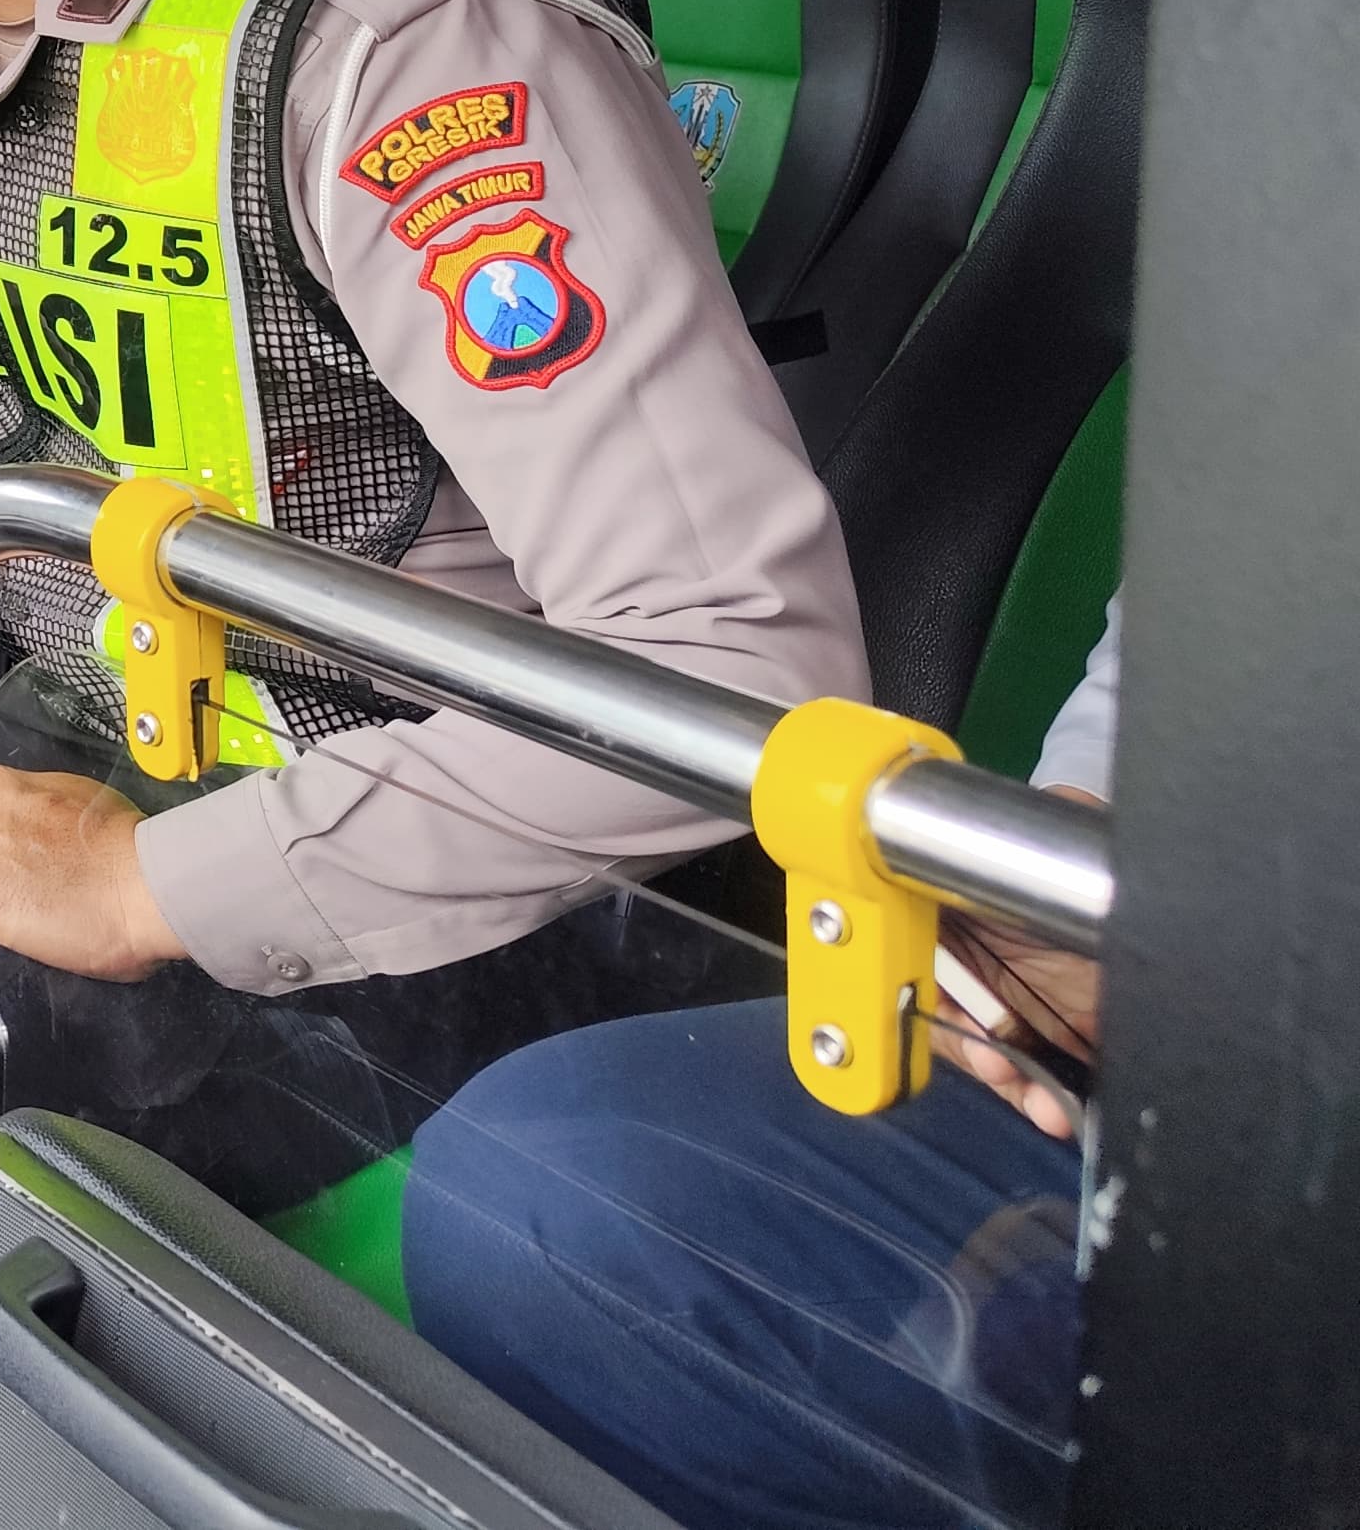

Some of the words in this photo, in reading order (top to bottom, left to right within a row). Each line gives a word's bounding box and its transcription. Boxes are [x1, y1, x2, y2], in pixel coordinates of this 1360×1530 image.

[359, 93, 511, 182] POLRES
[387, 119, 503, 183] GRESIK
[405, 192, 463, 240] JAWA
[456, 171, 531, 205] TIMUR
[49, 205, 210, 288] 12.5
